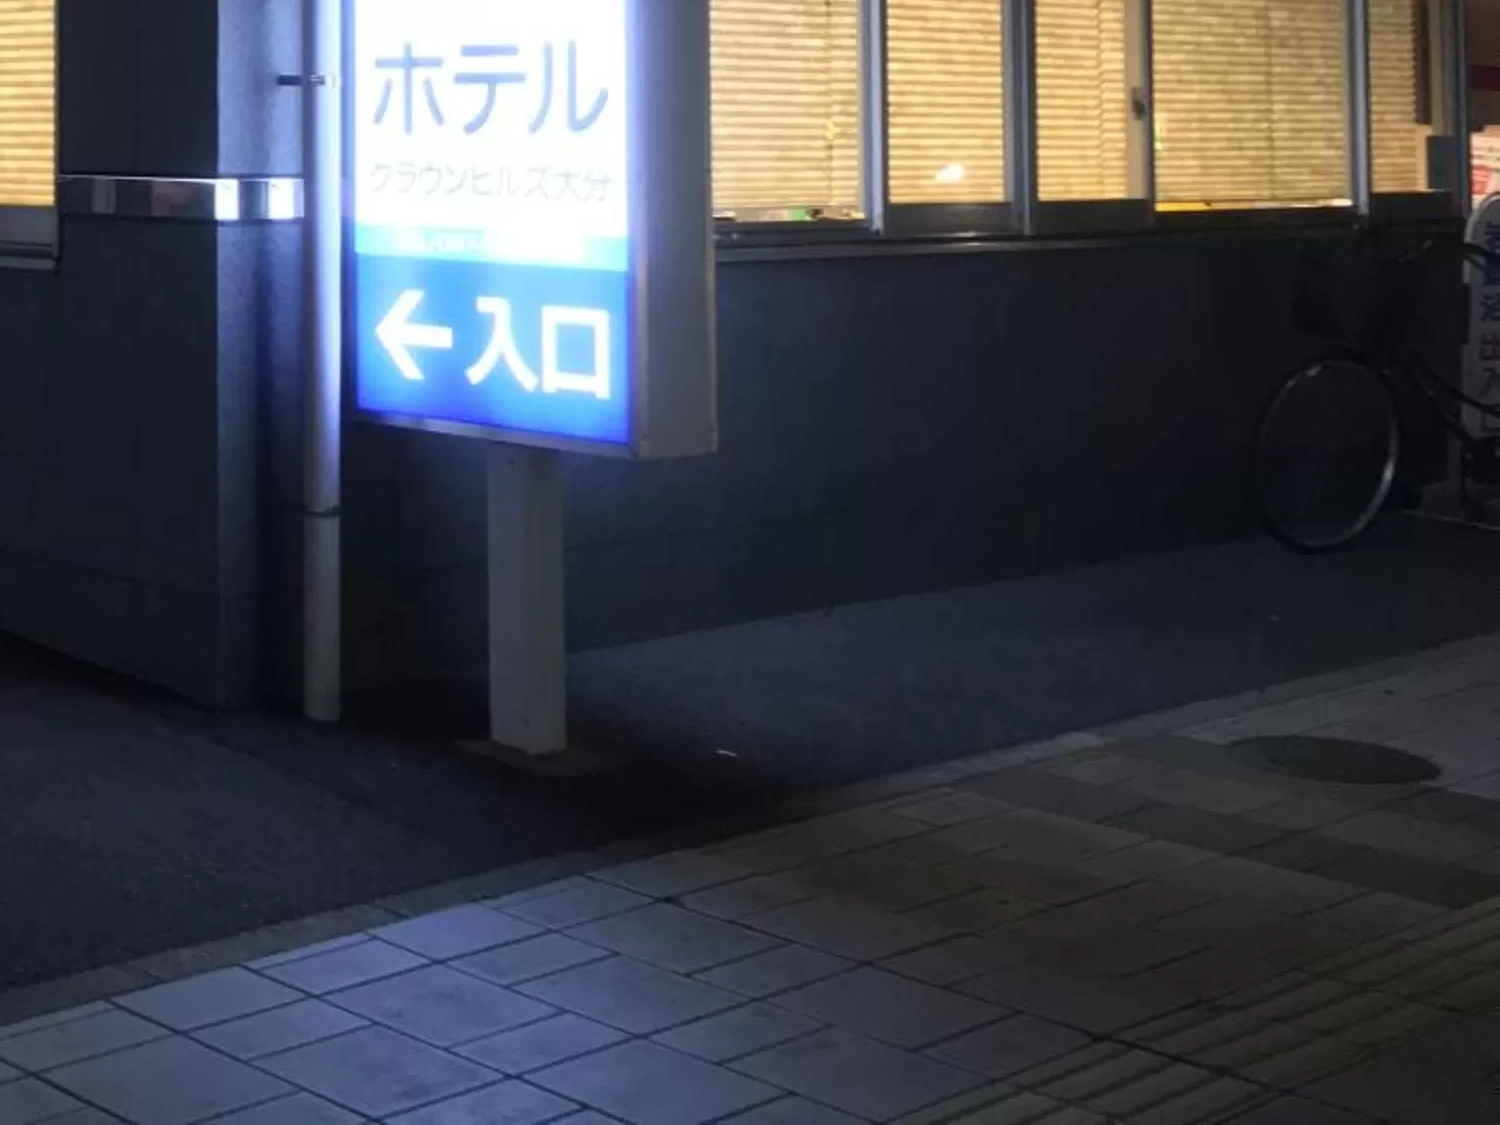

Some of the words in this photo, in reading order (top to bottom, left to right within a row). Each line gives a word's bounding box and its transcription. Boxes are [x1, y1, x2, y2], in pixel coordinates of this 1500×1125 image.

[373, 38, 609, 135] ホテル
[371, 161, 612, 203] クラウンヒルズ大分
[464, 295, 611, 400] 入口
